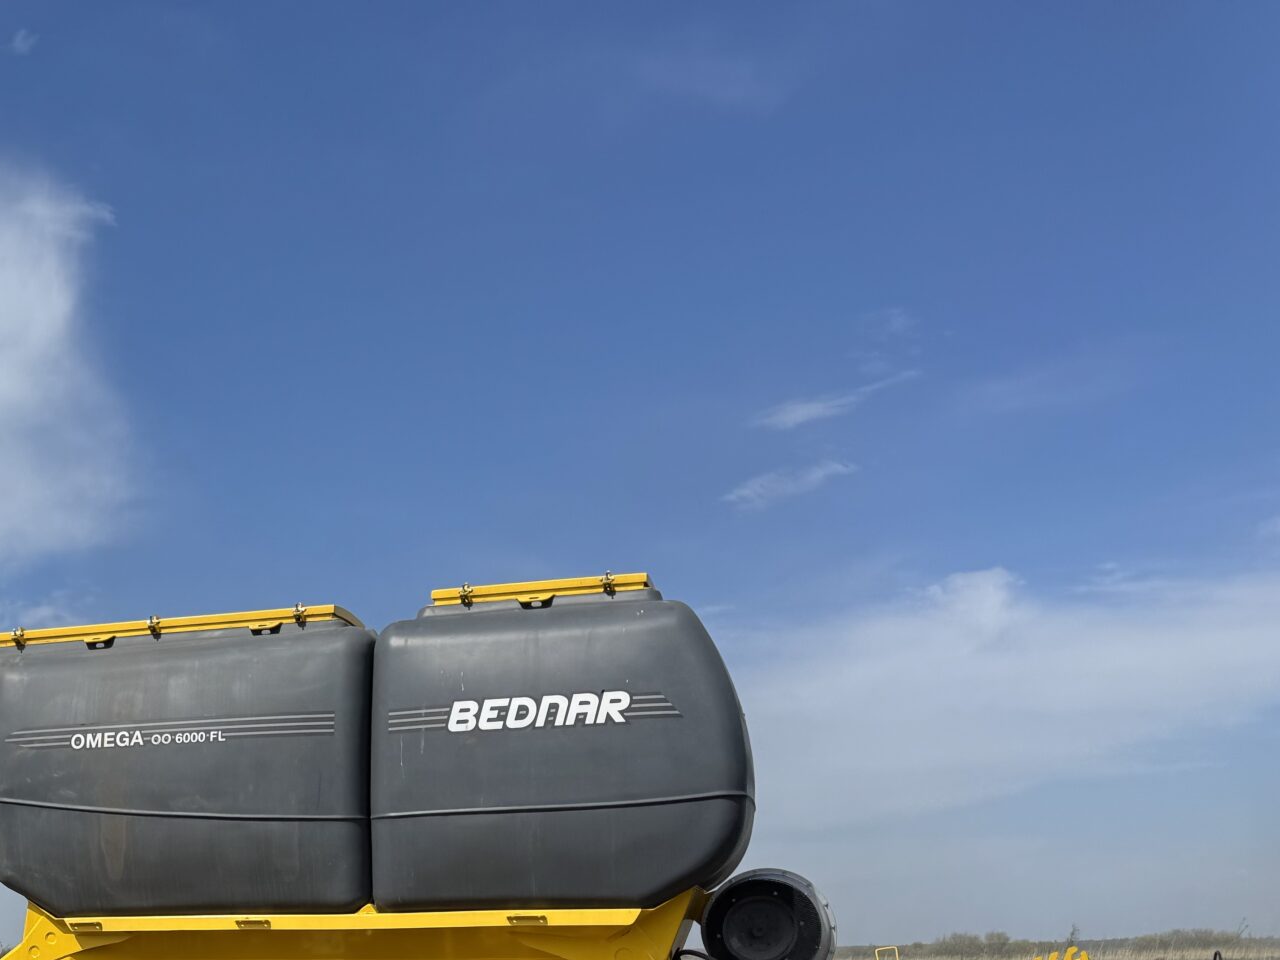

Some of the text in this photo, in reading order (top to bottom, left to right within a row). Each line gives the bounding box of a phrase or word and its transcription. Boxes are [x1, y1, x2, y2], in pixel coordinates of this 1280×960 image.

[447, 690, 631, 732] BEDNAR
[71, 731, 144, 749] OMEGA
[175, 732, 206, 744] 6000
[209, 731, 226, 742] FL
